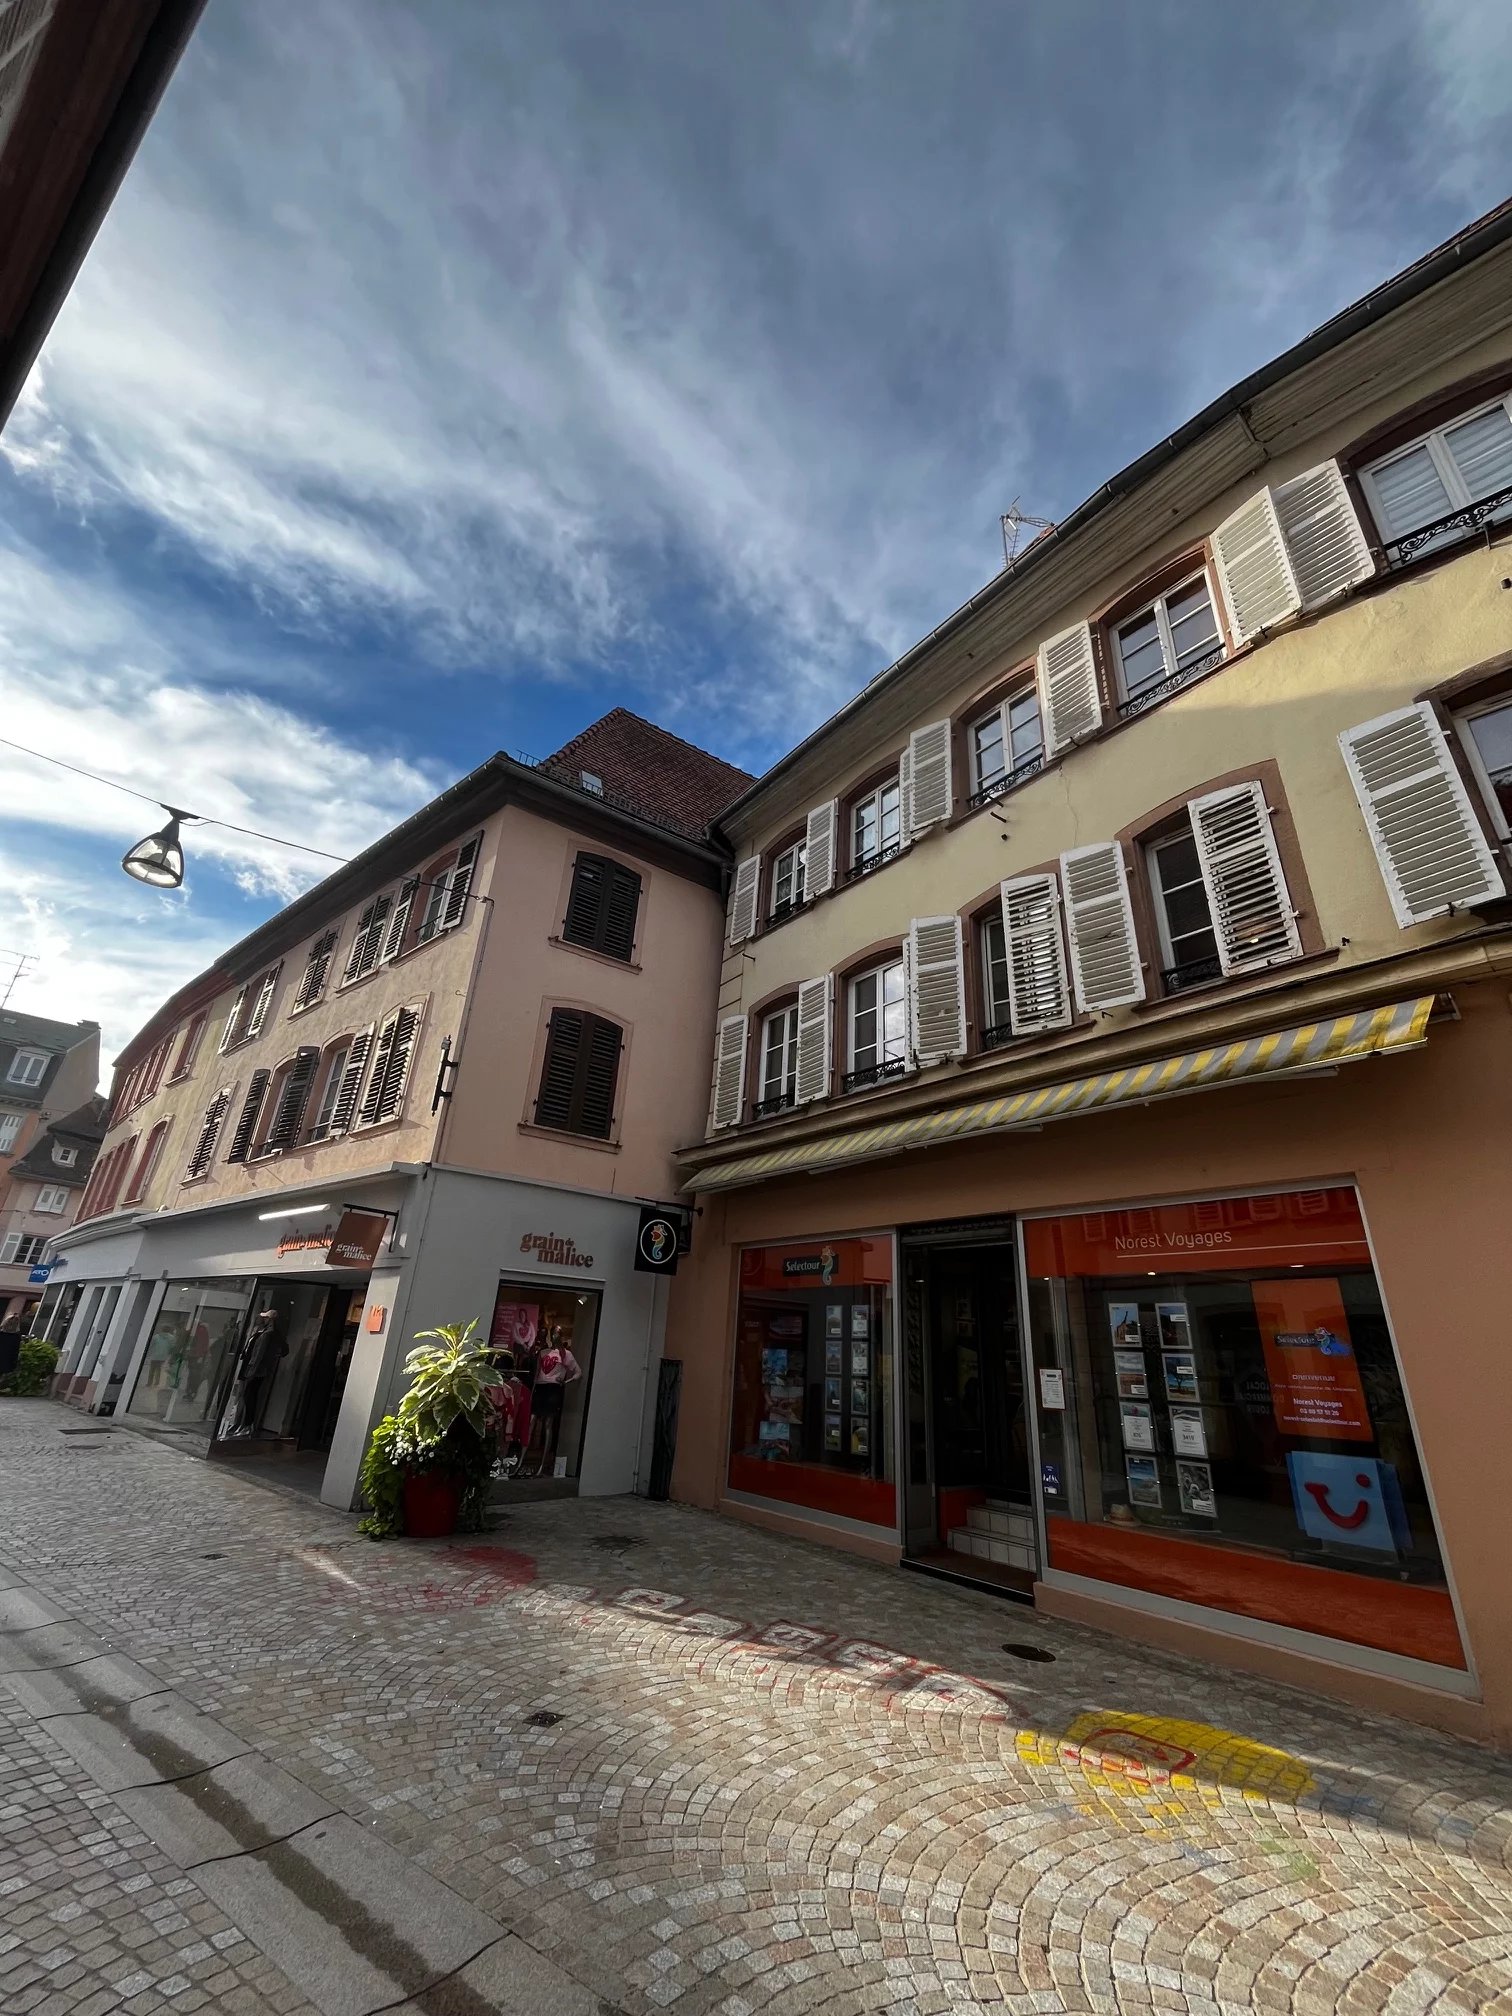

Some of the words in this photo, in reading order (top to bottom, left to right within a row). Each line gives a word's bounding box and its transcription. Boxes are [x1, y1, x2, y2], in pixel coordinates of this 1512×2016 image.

[336, 1243, 359, 1253] grain
[520, 1232, 564, 1253] grain
[1114, 1233, 1162, 1250] Norest
[1164, 1231, 1232, 1248] Voyages
[343, 1250, 372, 1260] malice
[537, 1245, 593, 1268] malice
[786, 1261, 820, 1272] Selectour
